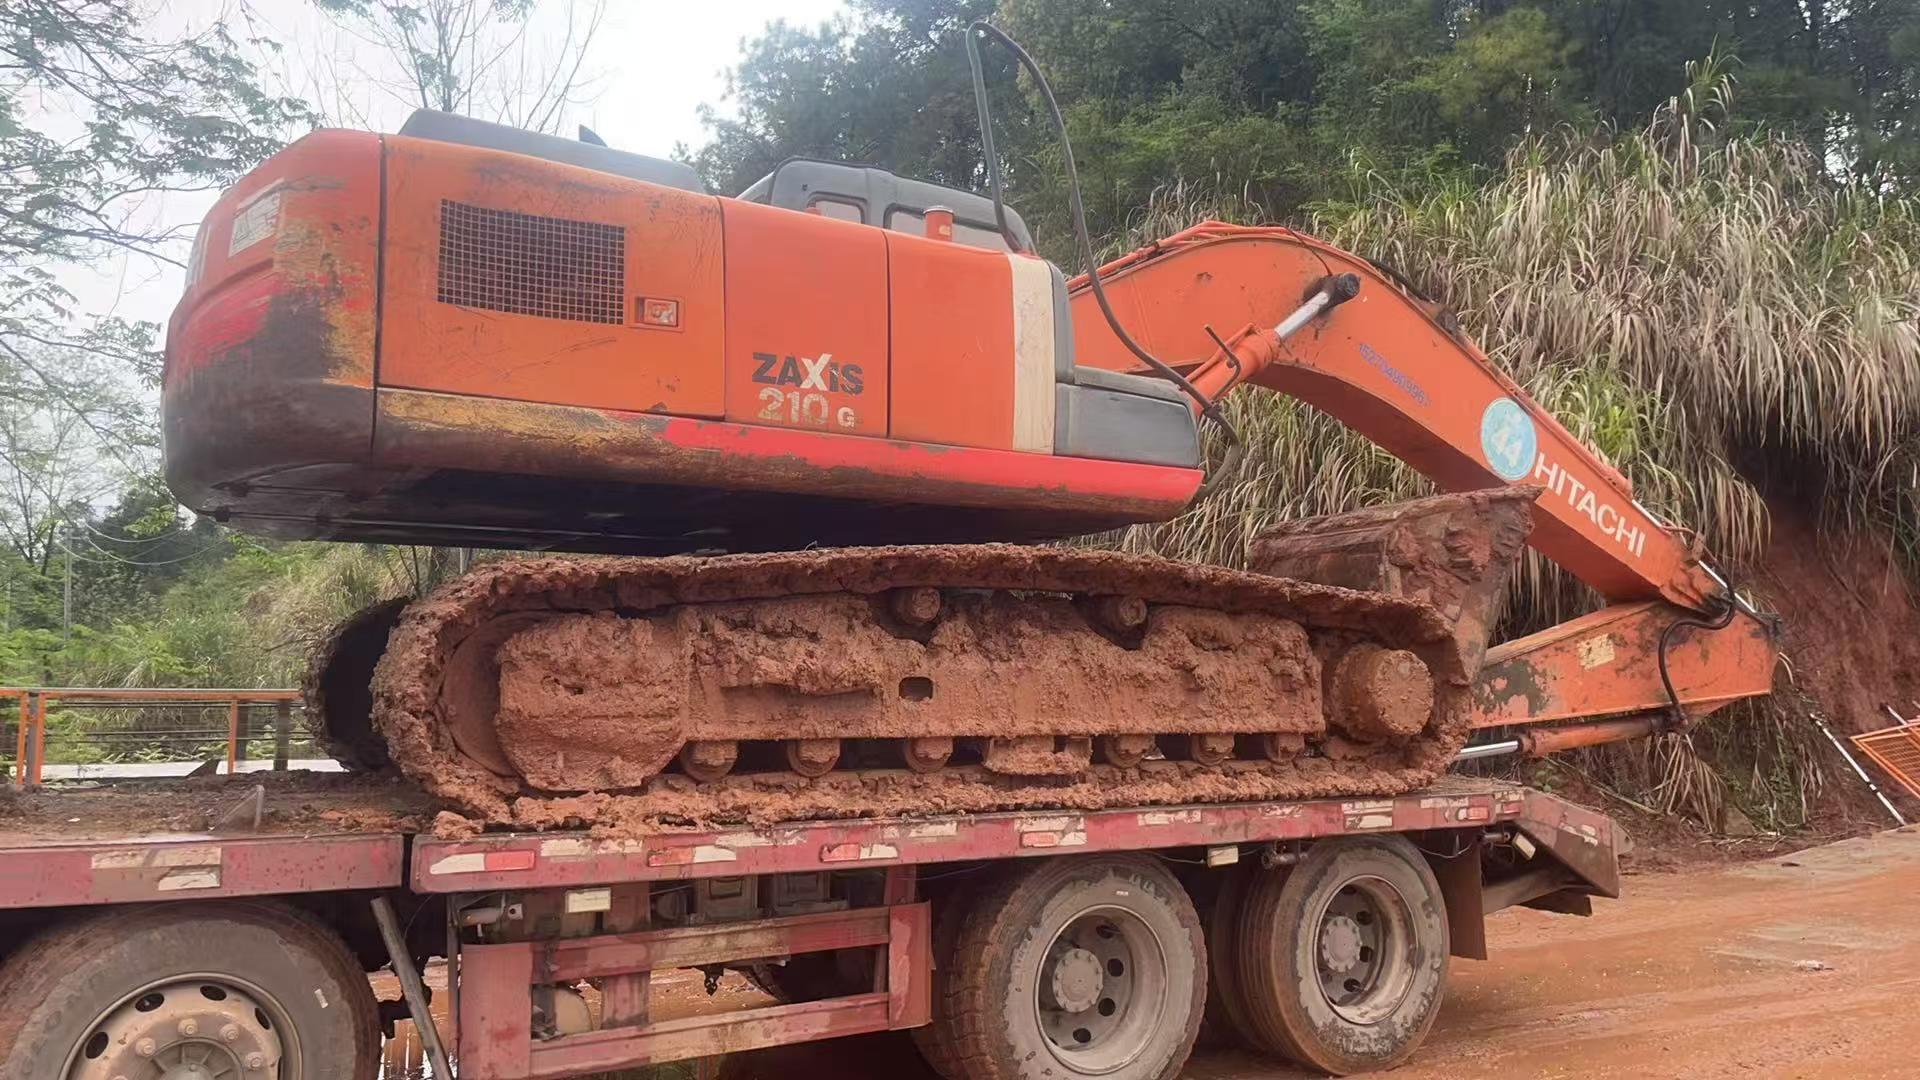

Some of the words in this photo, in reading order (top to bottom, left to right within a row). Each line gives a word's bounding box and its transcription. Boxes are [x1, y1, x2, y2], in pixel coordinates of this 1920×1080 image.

[758, 387, 829, 424] 210
[837, 406, 855, 427] G
[1534, 452, 1646, 558] HITACHI
